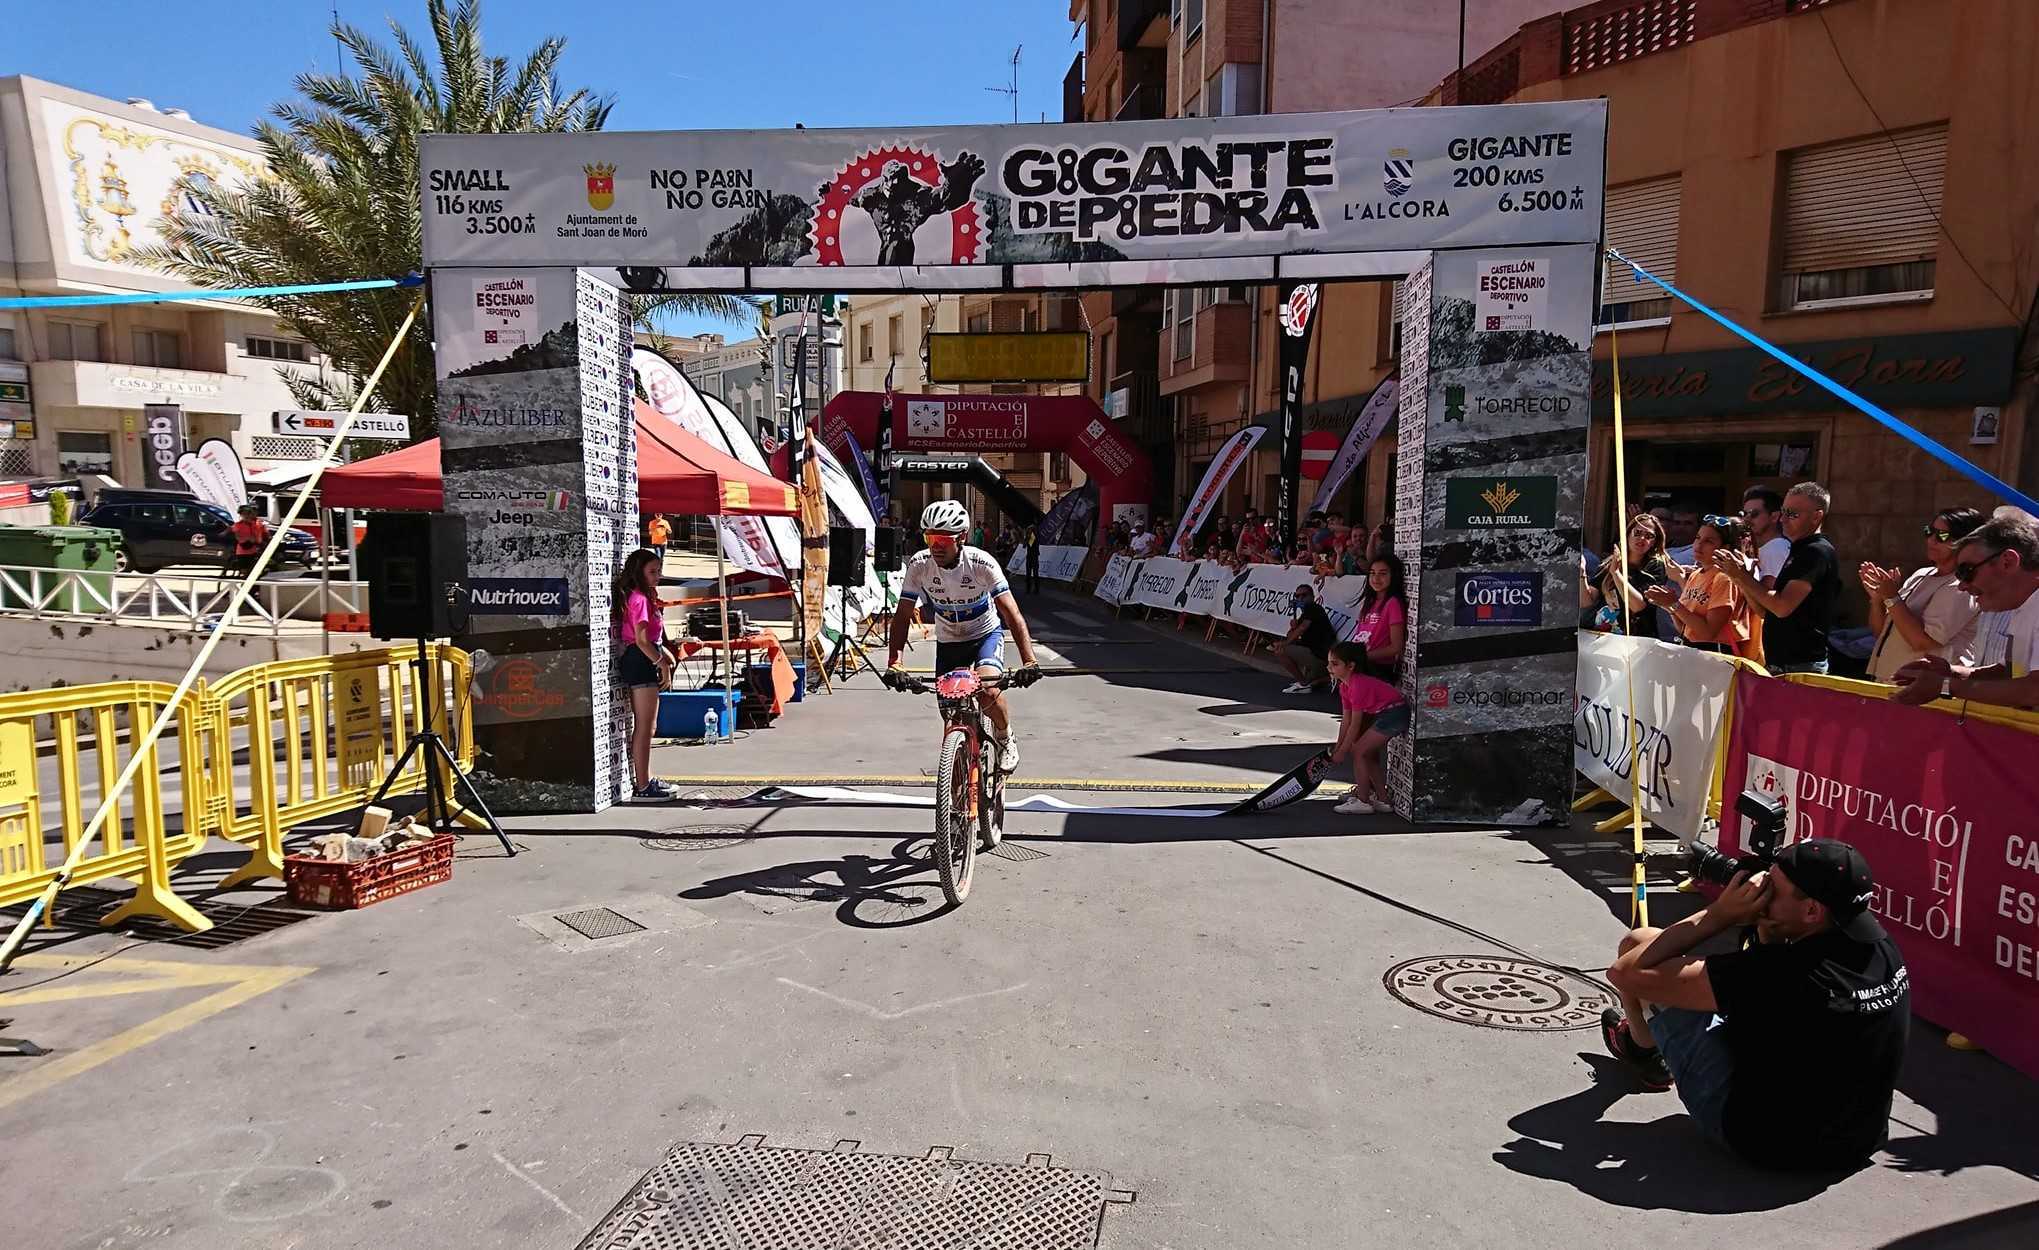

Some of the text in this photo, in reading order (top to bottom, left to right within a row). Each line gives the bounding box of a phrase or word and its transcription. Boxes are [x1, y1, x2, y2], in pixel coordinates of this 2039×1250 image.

[1448, 133, 1573, 161] GIGANTE
[430, 170, 510, 193] SMALL
[650, 168, 753, 189] NO PAIN
[1453, 165, 1544, 188] 200 KMS
[436, 195, 503, 215] 116 KMS
[666, 190, 704, 210] NO
[1497, 191, 1567, 214] 6.500
[1018, 200, 1078, 230] DE
[1344, 199, 1451, 222] L'ALCORA
[466, 216, 523, 235] 3.500
[565, 213, 638, 228] Ajuntament de
[556, 224, 648, 238] Sant Joan de Moró
[1490, 259, 1535, 275] CASTELLÓN
[484, 278, 524, 292] CASTELLÓN
[1480, 276, 1546, 291] ESCENARIO
[476, 293, 534, 307] ESCENARIO
[1490, 292, 1529, 303] DEPORTIVO
[485, 307, 521, 318] DEPORTIVO
[947, 400, 1023, 412] DIPUTACIÓ
[1474, 395, 1572, 414] TORRECID
[348, 420, 405, 431] ASTELLÓ
[463, 408, 567, 427] AZULIBER
[947, 413, 1023, 425] D E
[946, 425, 1023, 439] CASTELLÓ
[907, 461, 969, 470] FASTER
[458, 491, 547, 500] COMAUTO
[489, 509, 534, 527] Jeep
[1467, 514, 1532, 526] CAJA RURAL
[470, 588, 561, 607] Nutrinovex
[1463, 579, 1533, 605] Cortes
[1453, 688, 1566, 708] expojamar
[1799, 770, 1959, 848] DIPUTACIÓ
[1932, 858, 1953, 897] E
[1397, 958, 1566, 989] Telefónica
